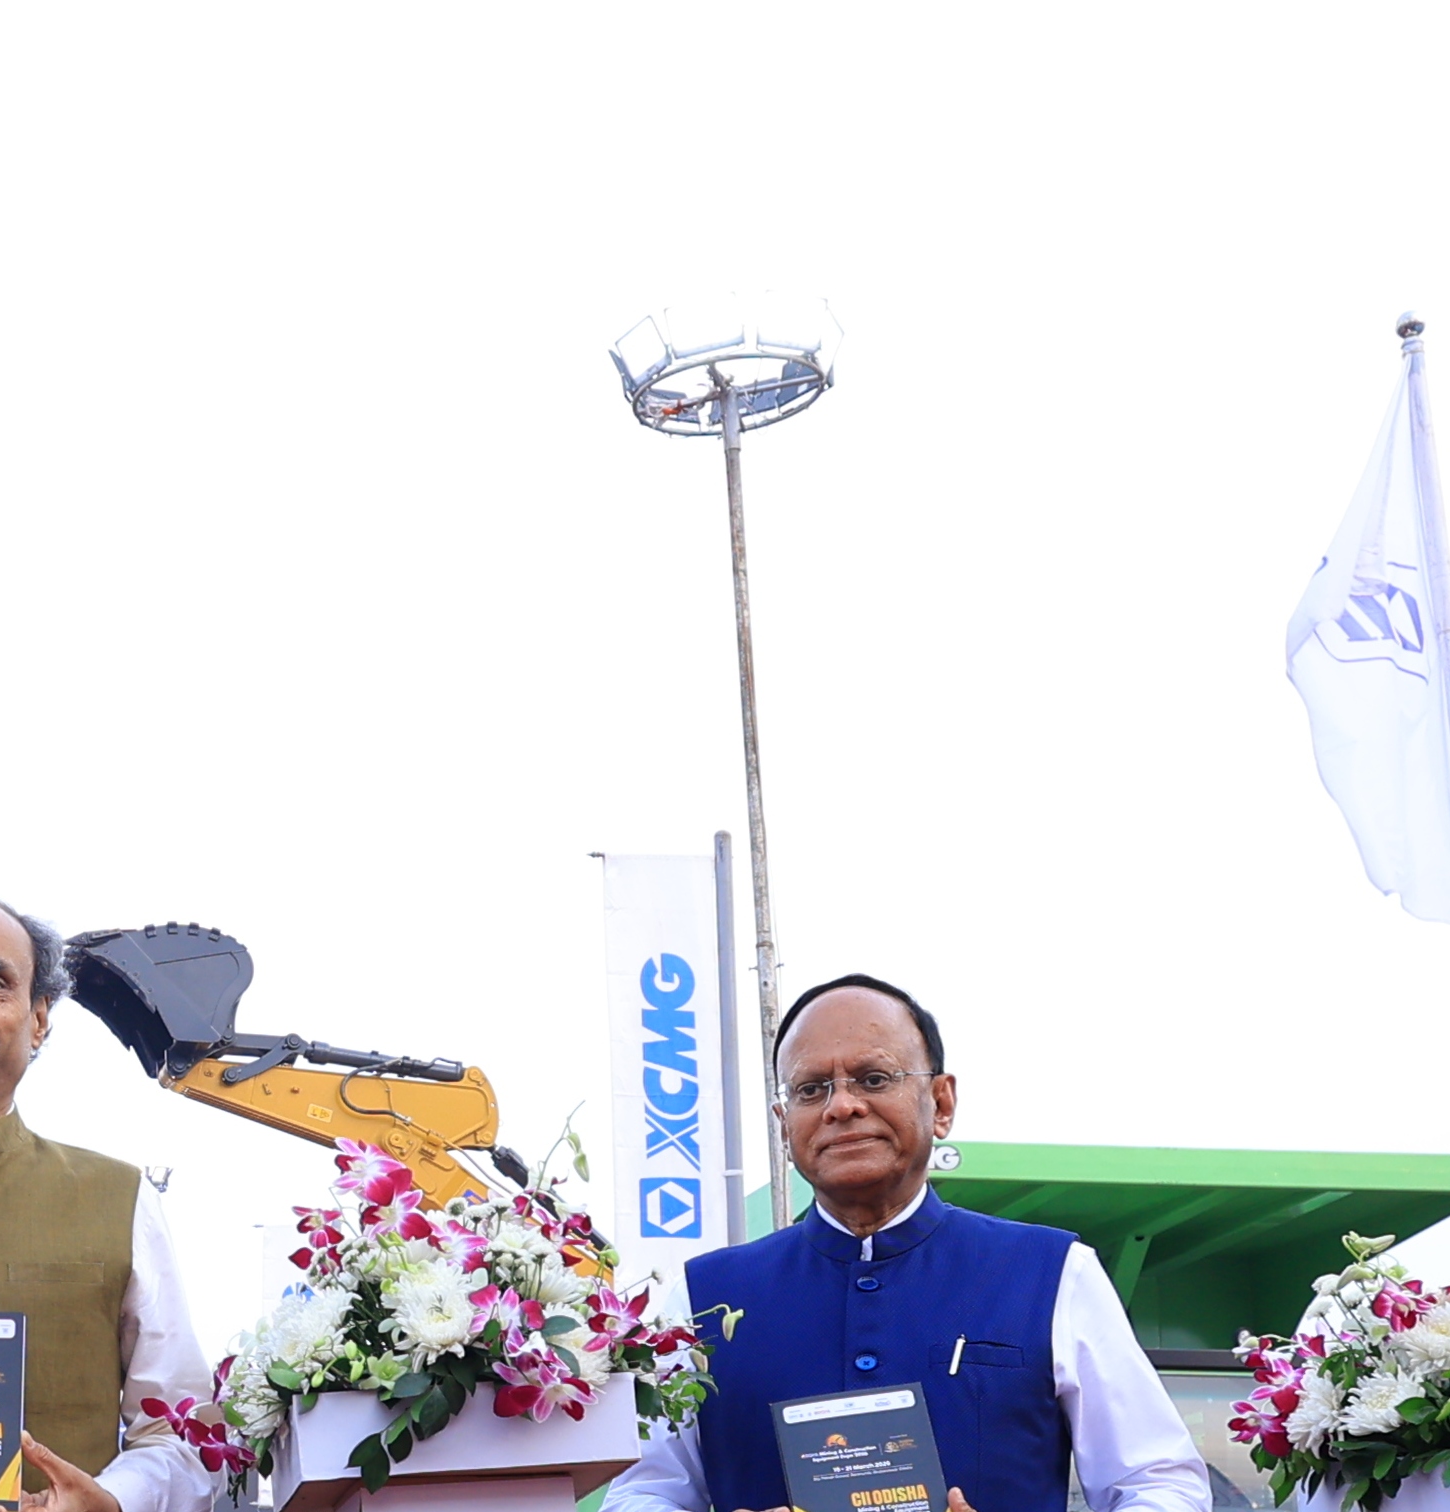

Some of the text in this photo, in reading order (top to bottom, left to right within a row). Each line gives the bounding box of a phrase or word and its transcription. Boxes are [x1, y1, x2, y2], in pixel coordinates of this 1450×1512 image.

[640, 953, 701, 1172] XCMG
[851, 1484, 928, 1507] CII ODISHA
[886, 1500, 929, 1510] Construction
